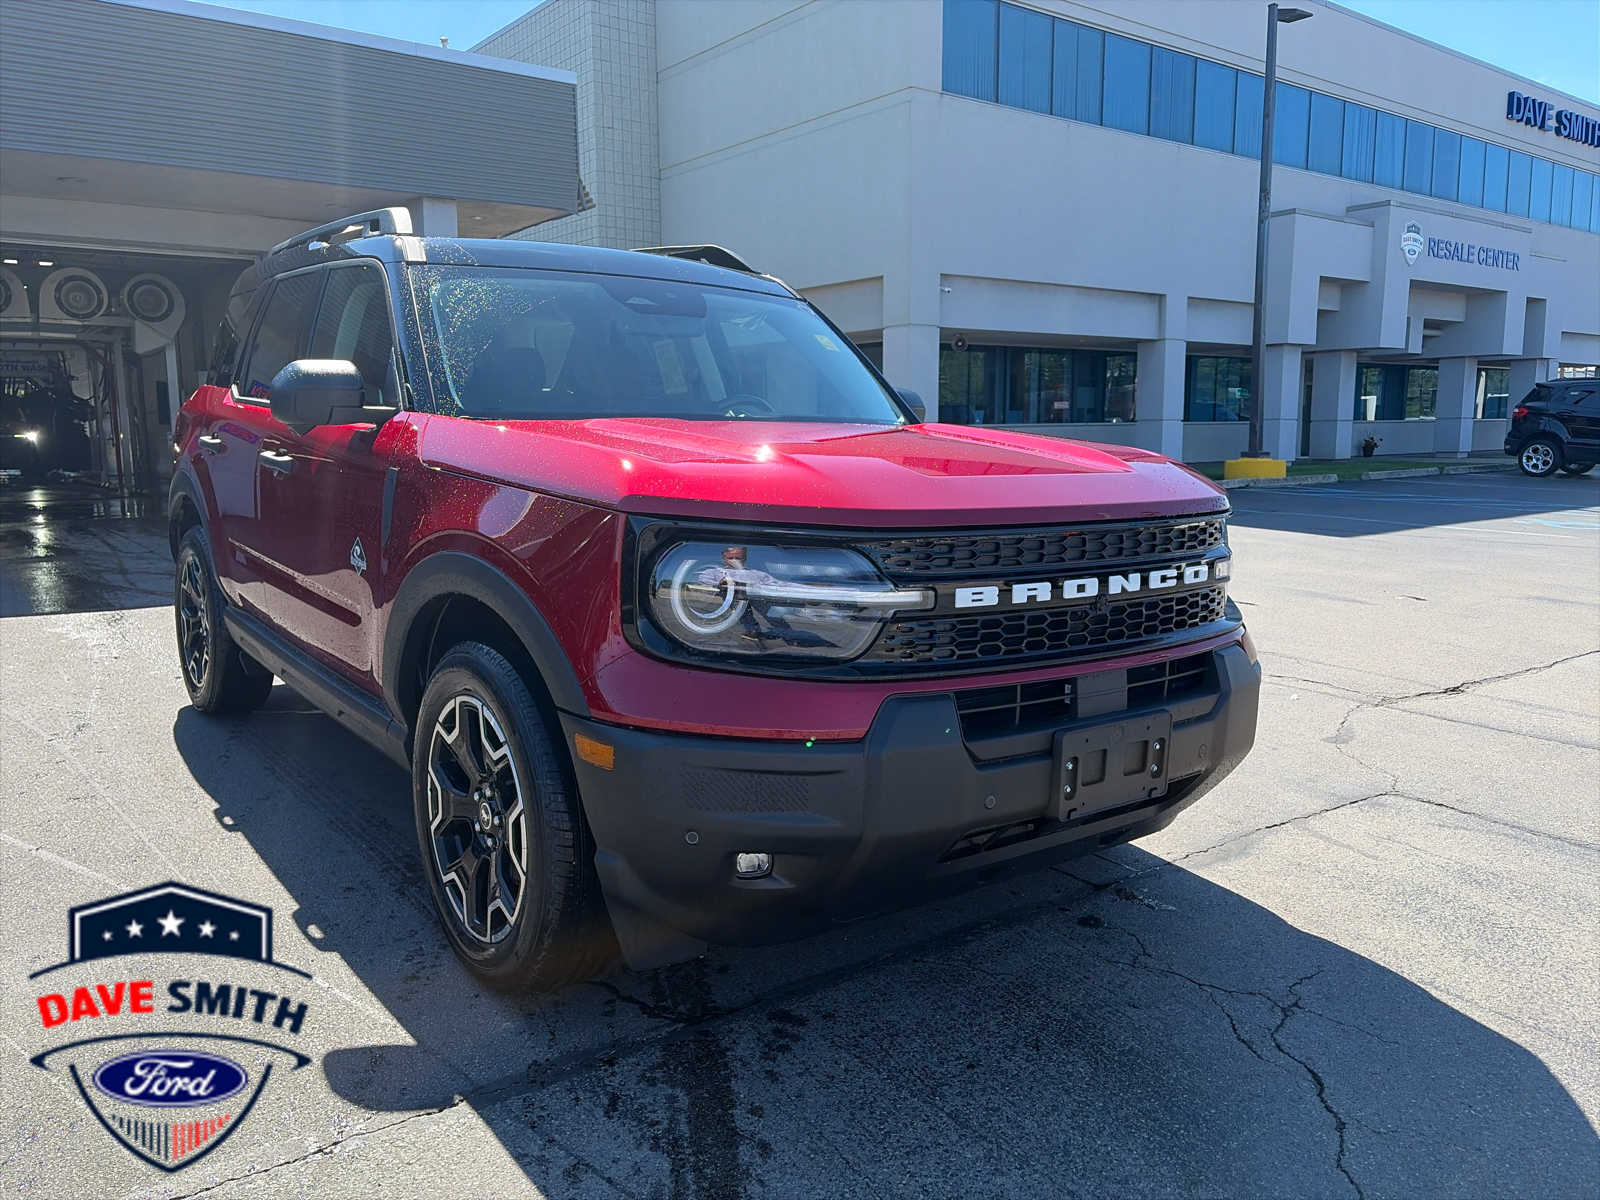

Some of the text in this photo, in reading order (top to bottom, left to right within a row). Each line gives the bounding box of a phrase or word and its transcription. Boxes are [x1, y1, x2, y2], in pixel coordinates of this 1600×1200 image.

[1507, 91, 1555, 132] DAVE
[1427, 236, 1475, 264] RESALE
[1477, 246, 1520, 272] CENTER
[955, 564, 1209, 608] BRONCO
